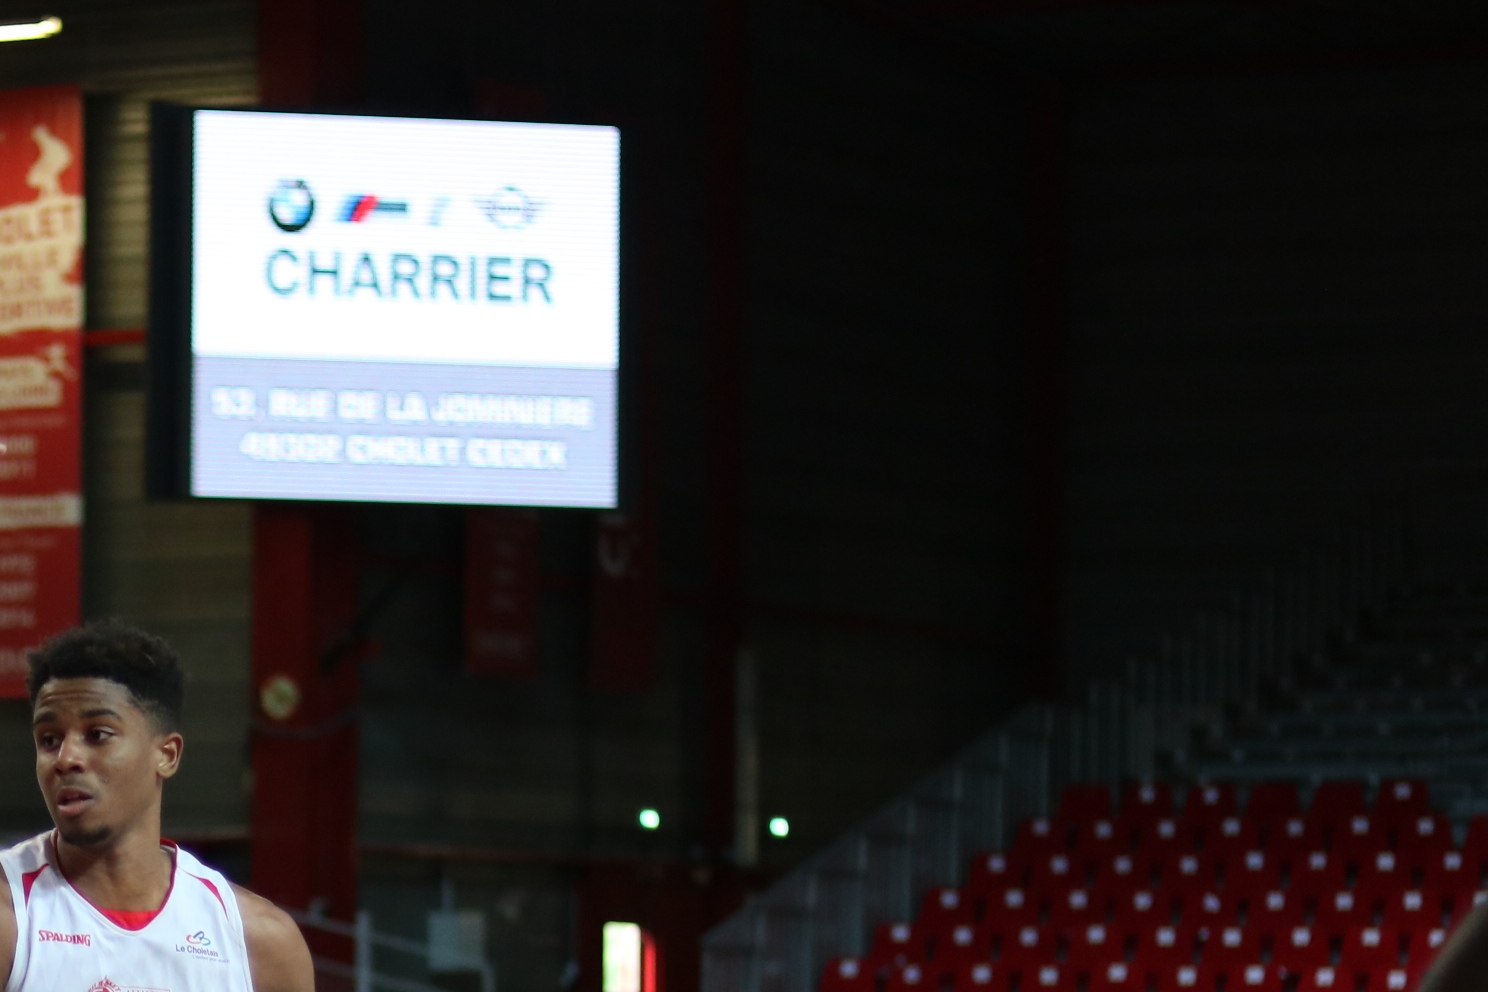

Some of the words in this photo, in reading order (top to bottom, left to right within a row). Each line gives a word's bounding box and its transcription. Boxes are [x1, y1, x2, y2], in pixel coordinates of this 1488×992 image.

[266, 248, 554, 304] CHARRIER
[386, 390, 428, 424] LA
[346, 434, 461, 466] CHOLET
[38, 929, 91, 947] SPALDING
